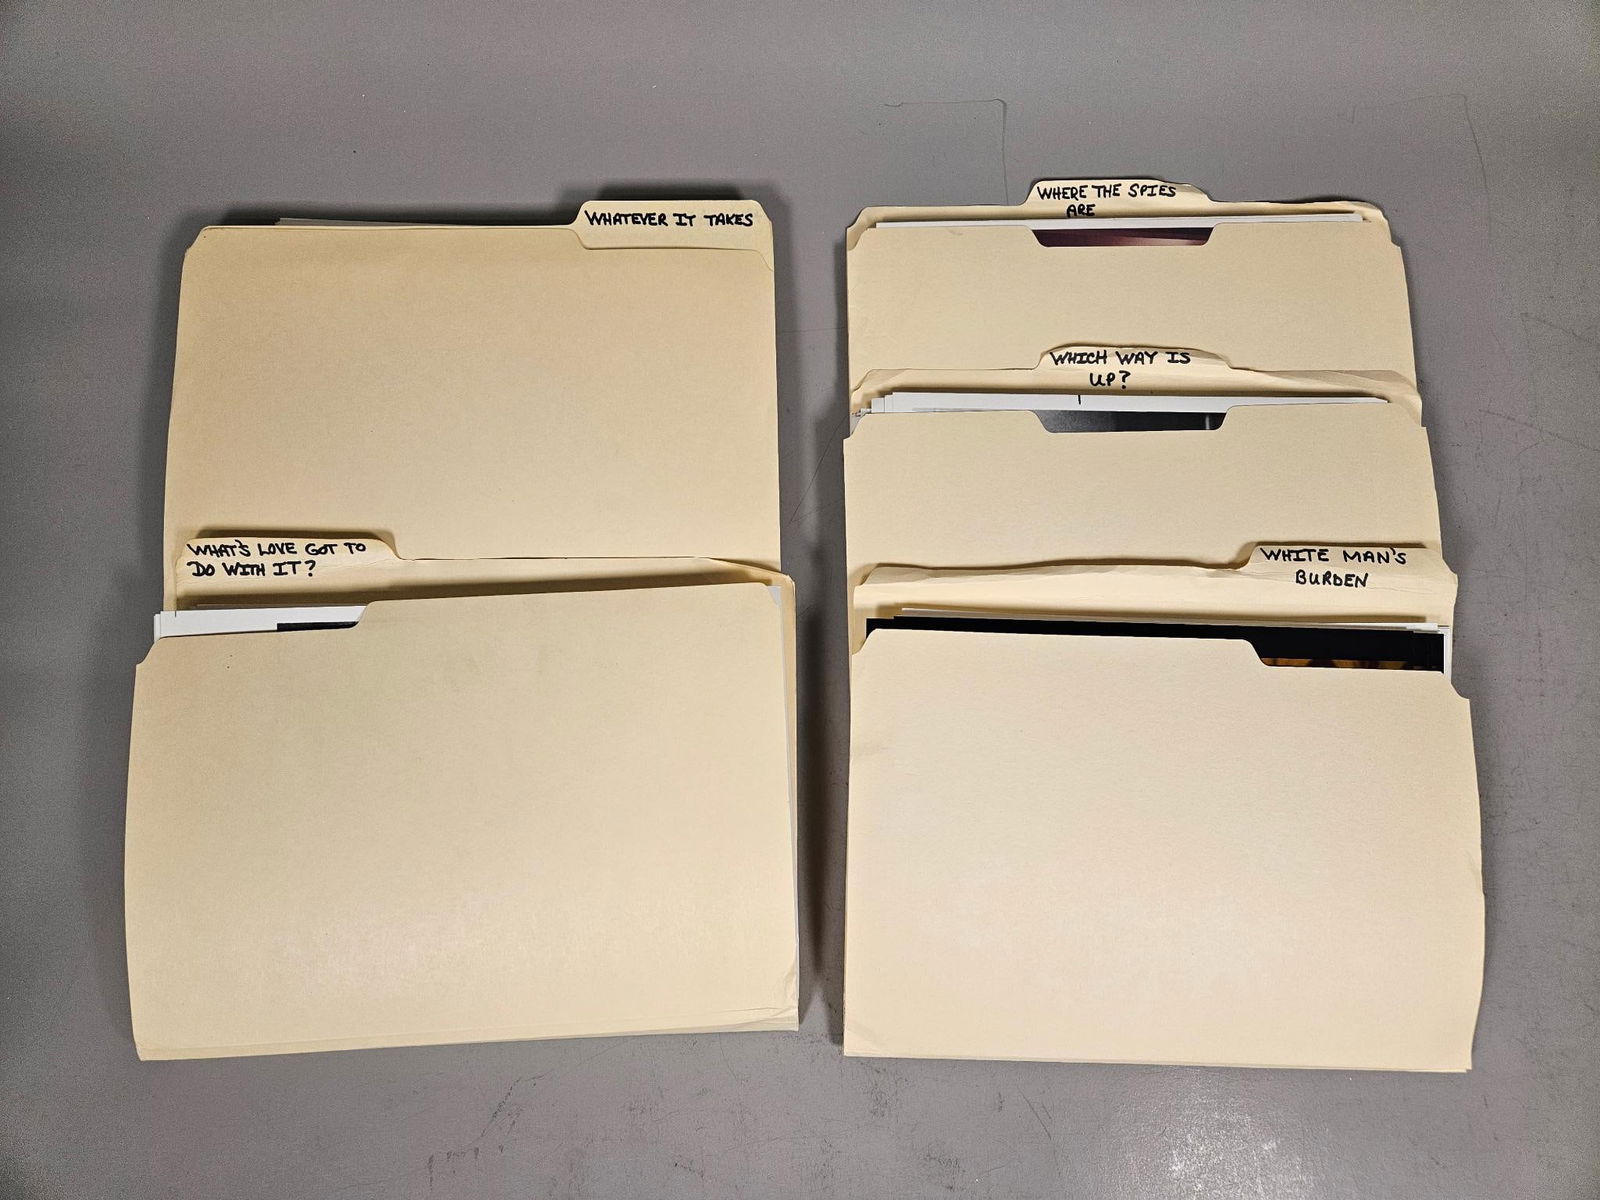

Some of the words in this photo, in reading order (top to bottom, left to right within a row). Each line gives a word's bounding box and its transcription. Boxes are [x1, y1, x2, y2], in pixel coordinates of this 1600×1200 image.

[1036, 185, 1089, 201] WHERE
[1091, 183, 1122, 198] THE
[1128, 183, 1177, 198] SPIES
[584, 209, 669, 227] WHATEVER
[672, 212, 697, 227] IT
[703, 212, 754, 227] TAKES
[1066, 203, 1096, 218] ARE
[1049, 350, 1108, 366] WHICH
[1115, 350, 1159, 366] WAY
[1165, 351, 1192, 365] IS
[1089, 370, 1131, 390] UP?
[186, 539, 251, 558] WHAT'S
[257, 542, 298, 557] LOVE
[304, 542, 338, 556] GOT
[343, 542, 367, 555] TO
[1259, 547, 1330, 563] WHITE
[1343, 547, 1407, 565] MAN'S
[186, 560, 216, 577] DO
[221, 561, 266, 577] WITH
[1295, 569, 1369, 588] BURDEN
